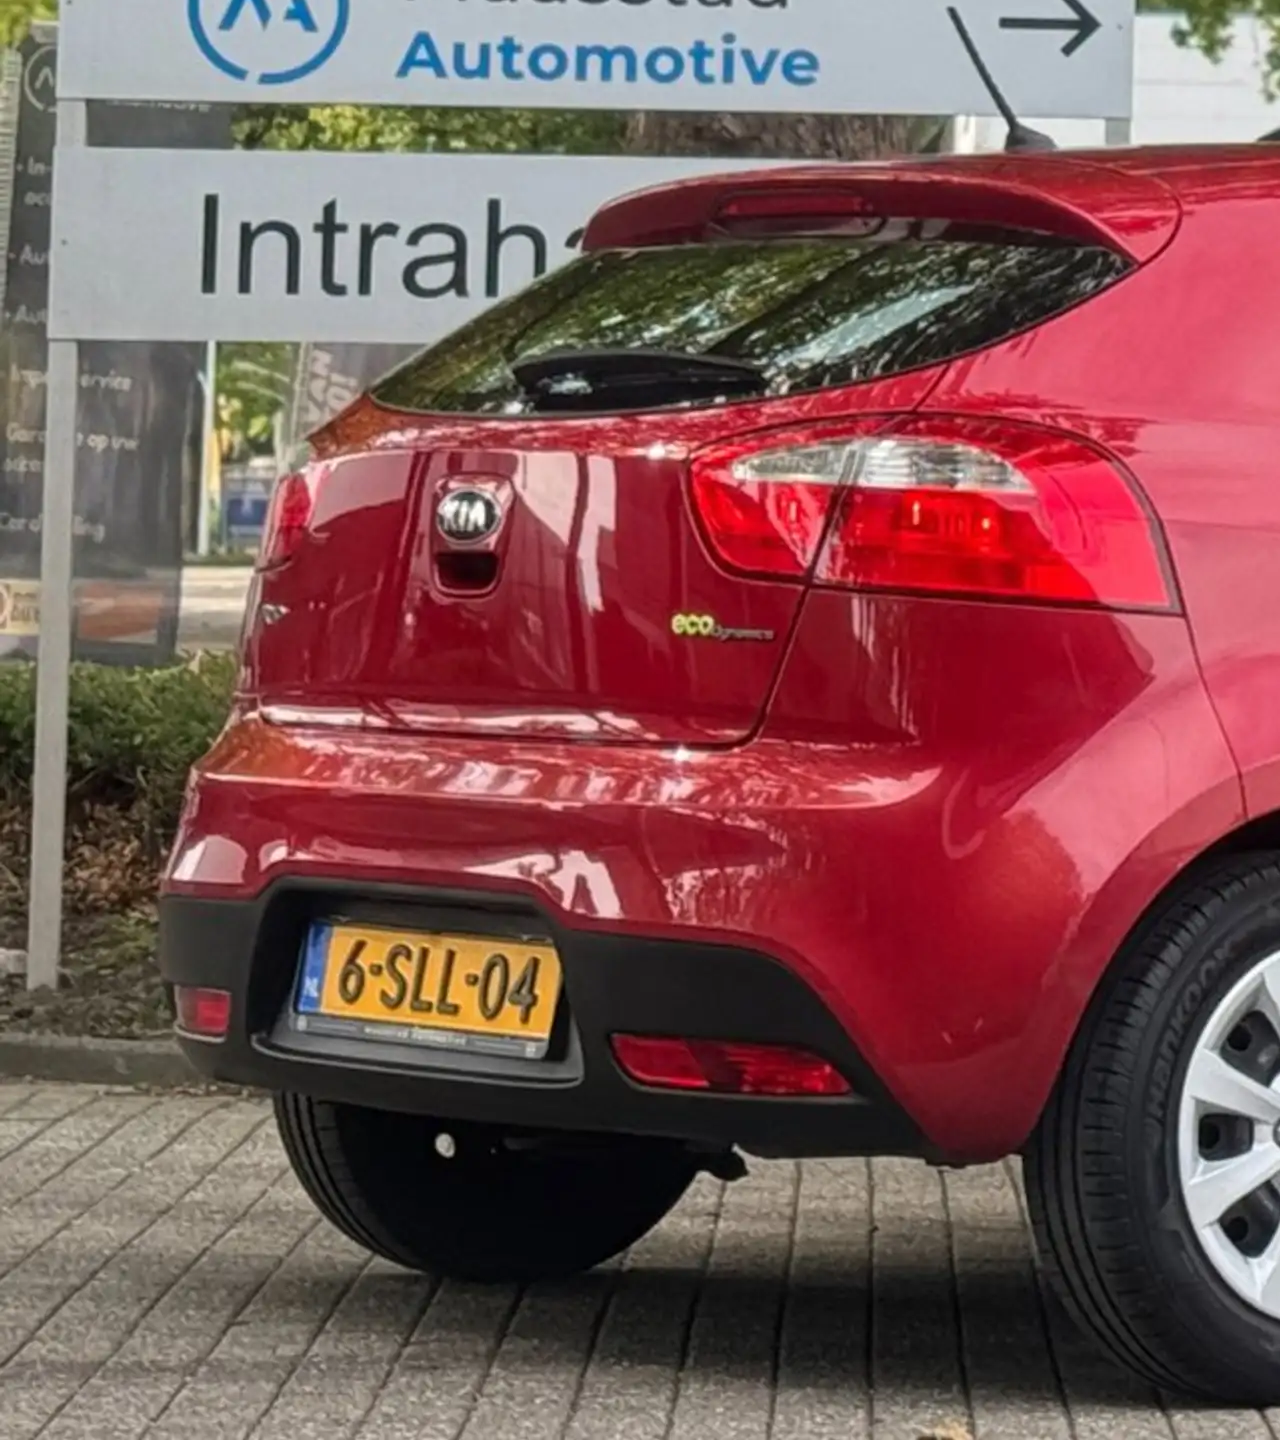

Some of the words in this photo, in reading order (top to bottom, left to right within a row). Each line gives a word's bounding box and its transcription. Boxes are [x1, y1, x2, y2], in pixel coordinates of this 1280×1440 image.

[396, 31, 821, 86] Automotive
[201, 193, 586, 297] Intrah
[338, 940, 540, 1025] 6-SLL-04
